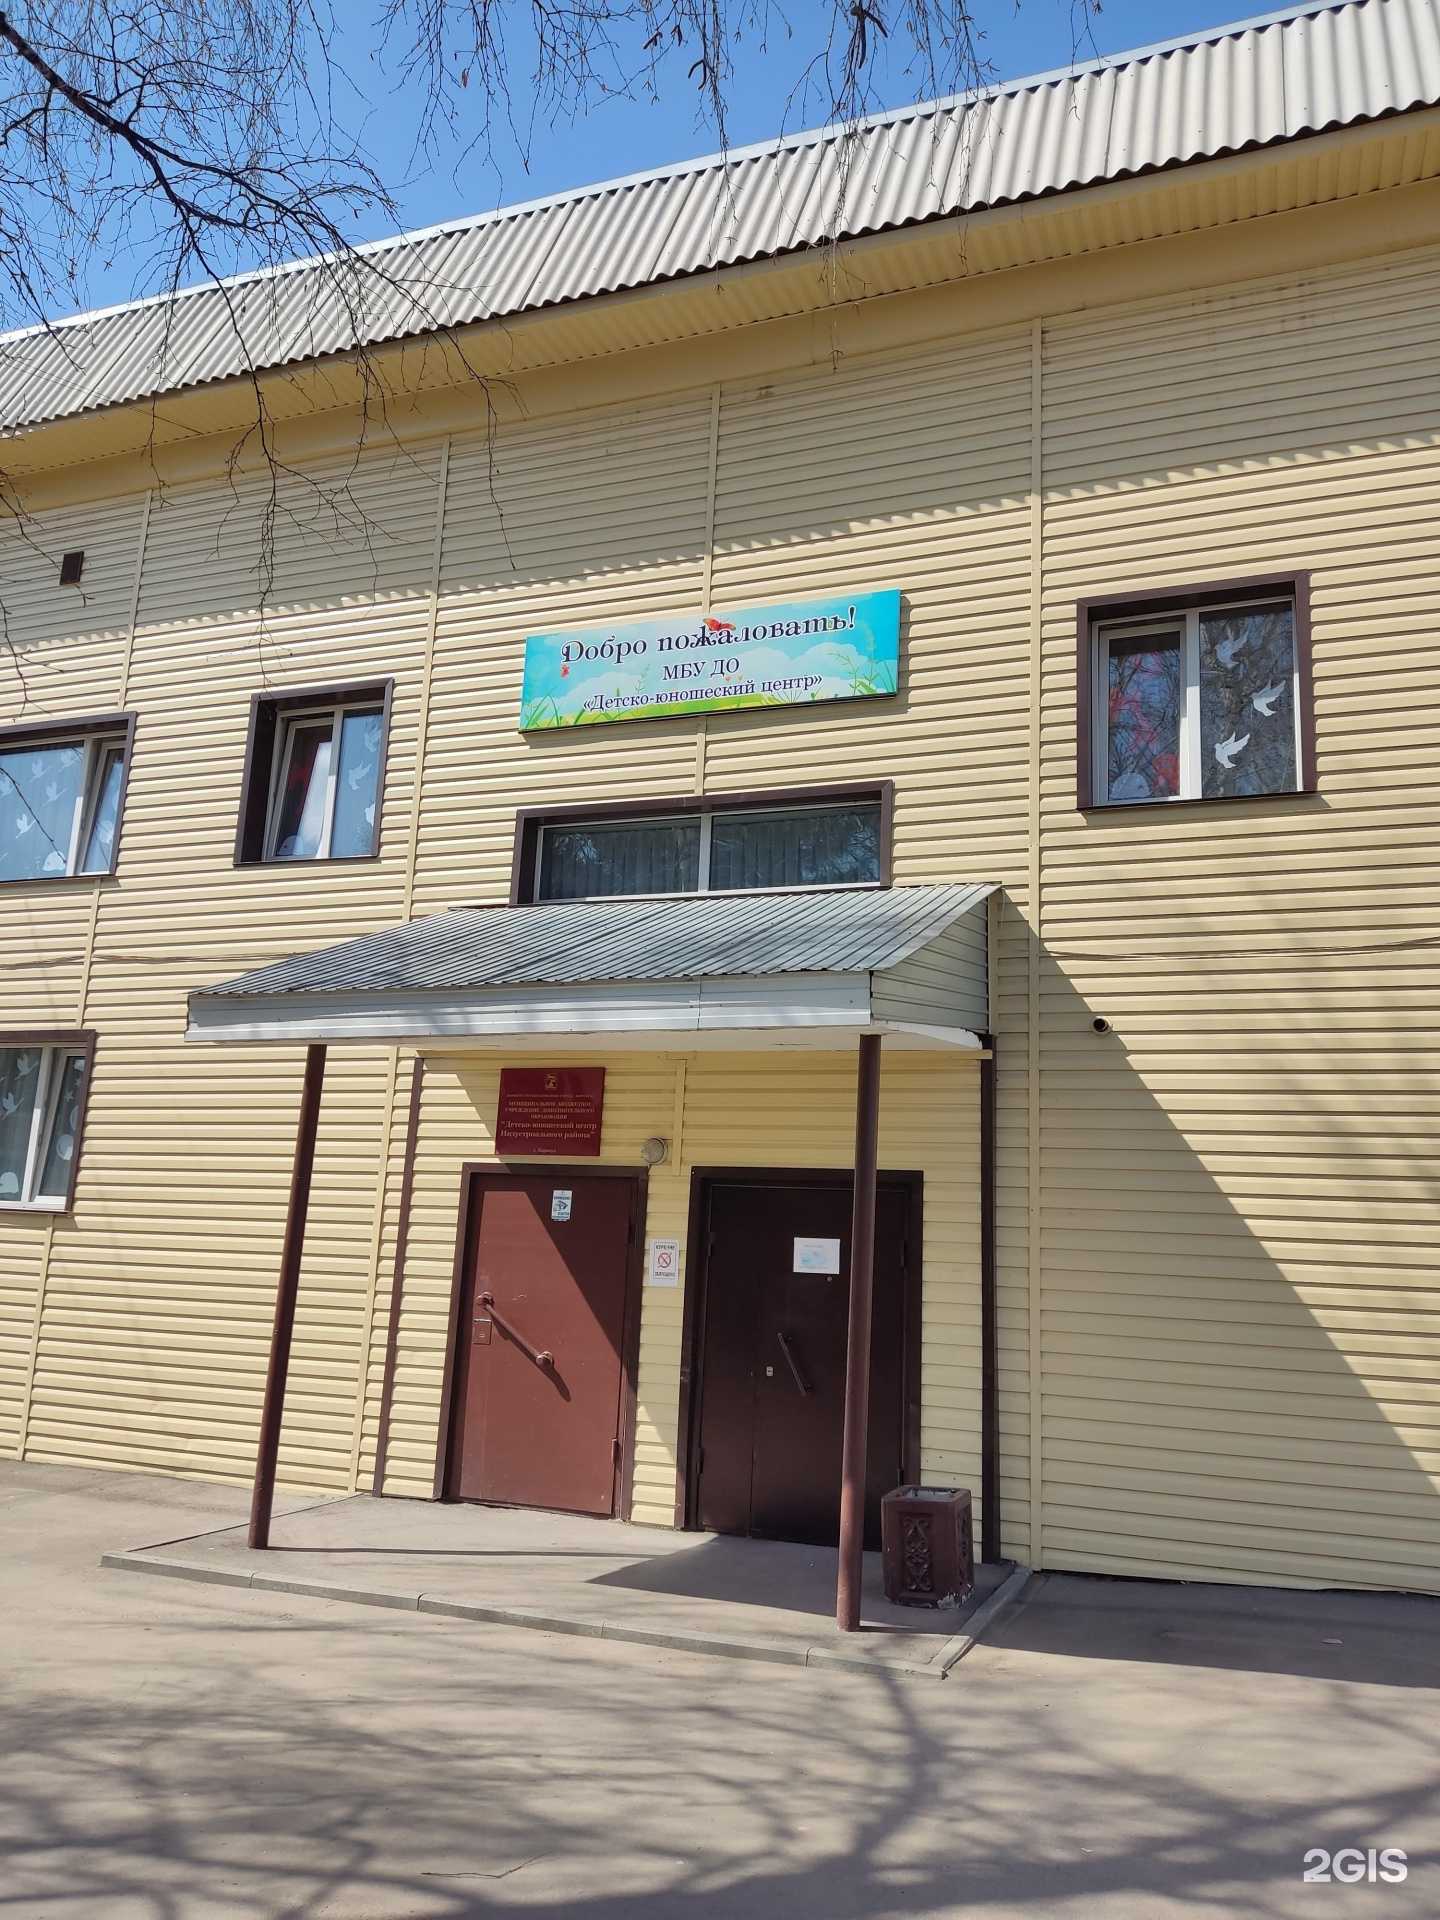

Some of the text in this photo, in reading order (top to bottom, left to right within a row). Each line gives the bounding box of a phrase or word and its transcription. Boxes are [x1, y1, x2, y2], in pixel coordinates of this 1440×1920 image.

[561, 605, 857, 664] Добро пожаловать!
[663, 657, 740, 682] МБУ ДО
[583, 674, 823, 712] «Детско-юношеский центр»
